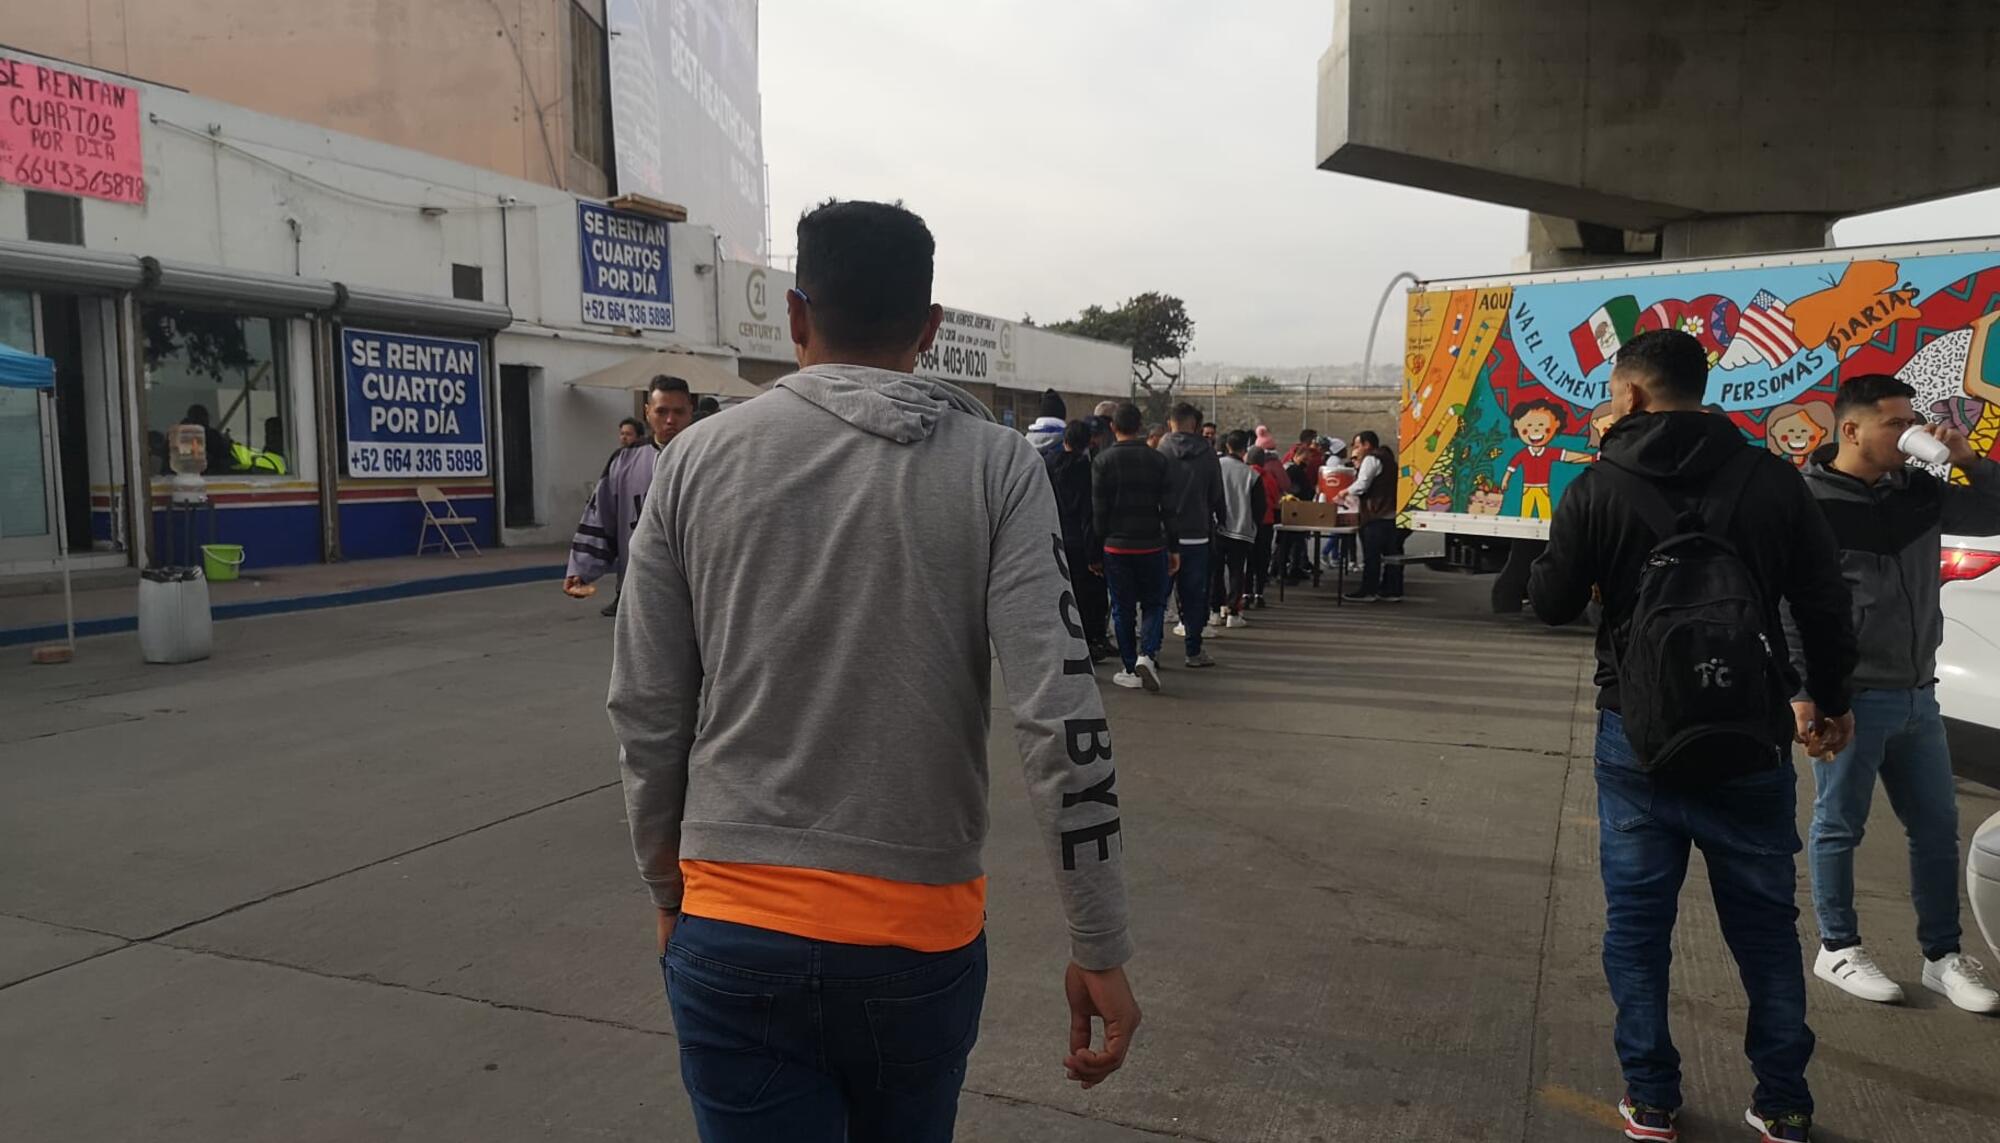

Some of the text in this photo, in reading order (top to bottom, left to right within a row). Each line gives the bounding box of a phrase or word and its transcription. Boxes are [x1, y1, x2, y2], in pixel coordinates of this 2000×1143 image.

[37, 66, 125, 108] RENTAN
[10, 95, 116, 141] CUARTOS
[32, 128, 63, 152] POR
[76, 136, 115, 161] DIA
[15, 153, 145, 200] 6643365898
[584, 211, 666, 247] SE RENTAN
[592, 239, 661, 271] CUARTOS
[598, 266, 657, 295] POR DÍA
[585, 300, 672, 327] +52 664 336 5898
[351, 339, 474, 375] SE RENTAN
[1720, 281, 1921, 403] PERSONAS DIARIAS
[362, 372, 466, 405] CUARTOS
[1538, 355, 1613, 400] ALIMENT
[370, 403, 460, 434] POR DÍA
[351, 448, 483, 472] +52 664 336 5898
[1060, 718, 1123, 871] BYE
